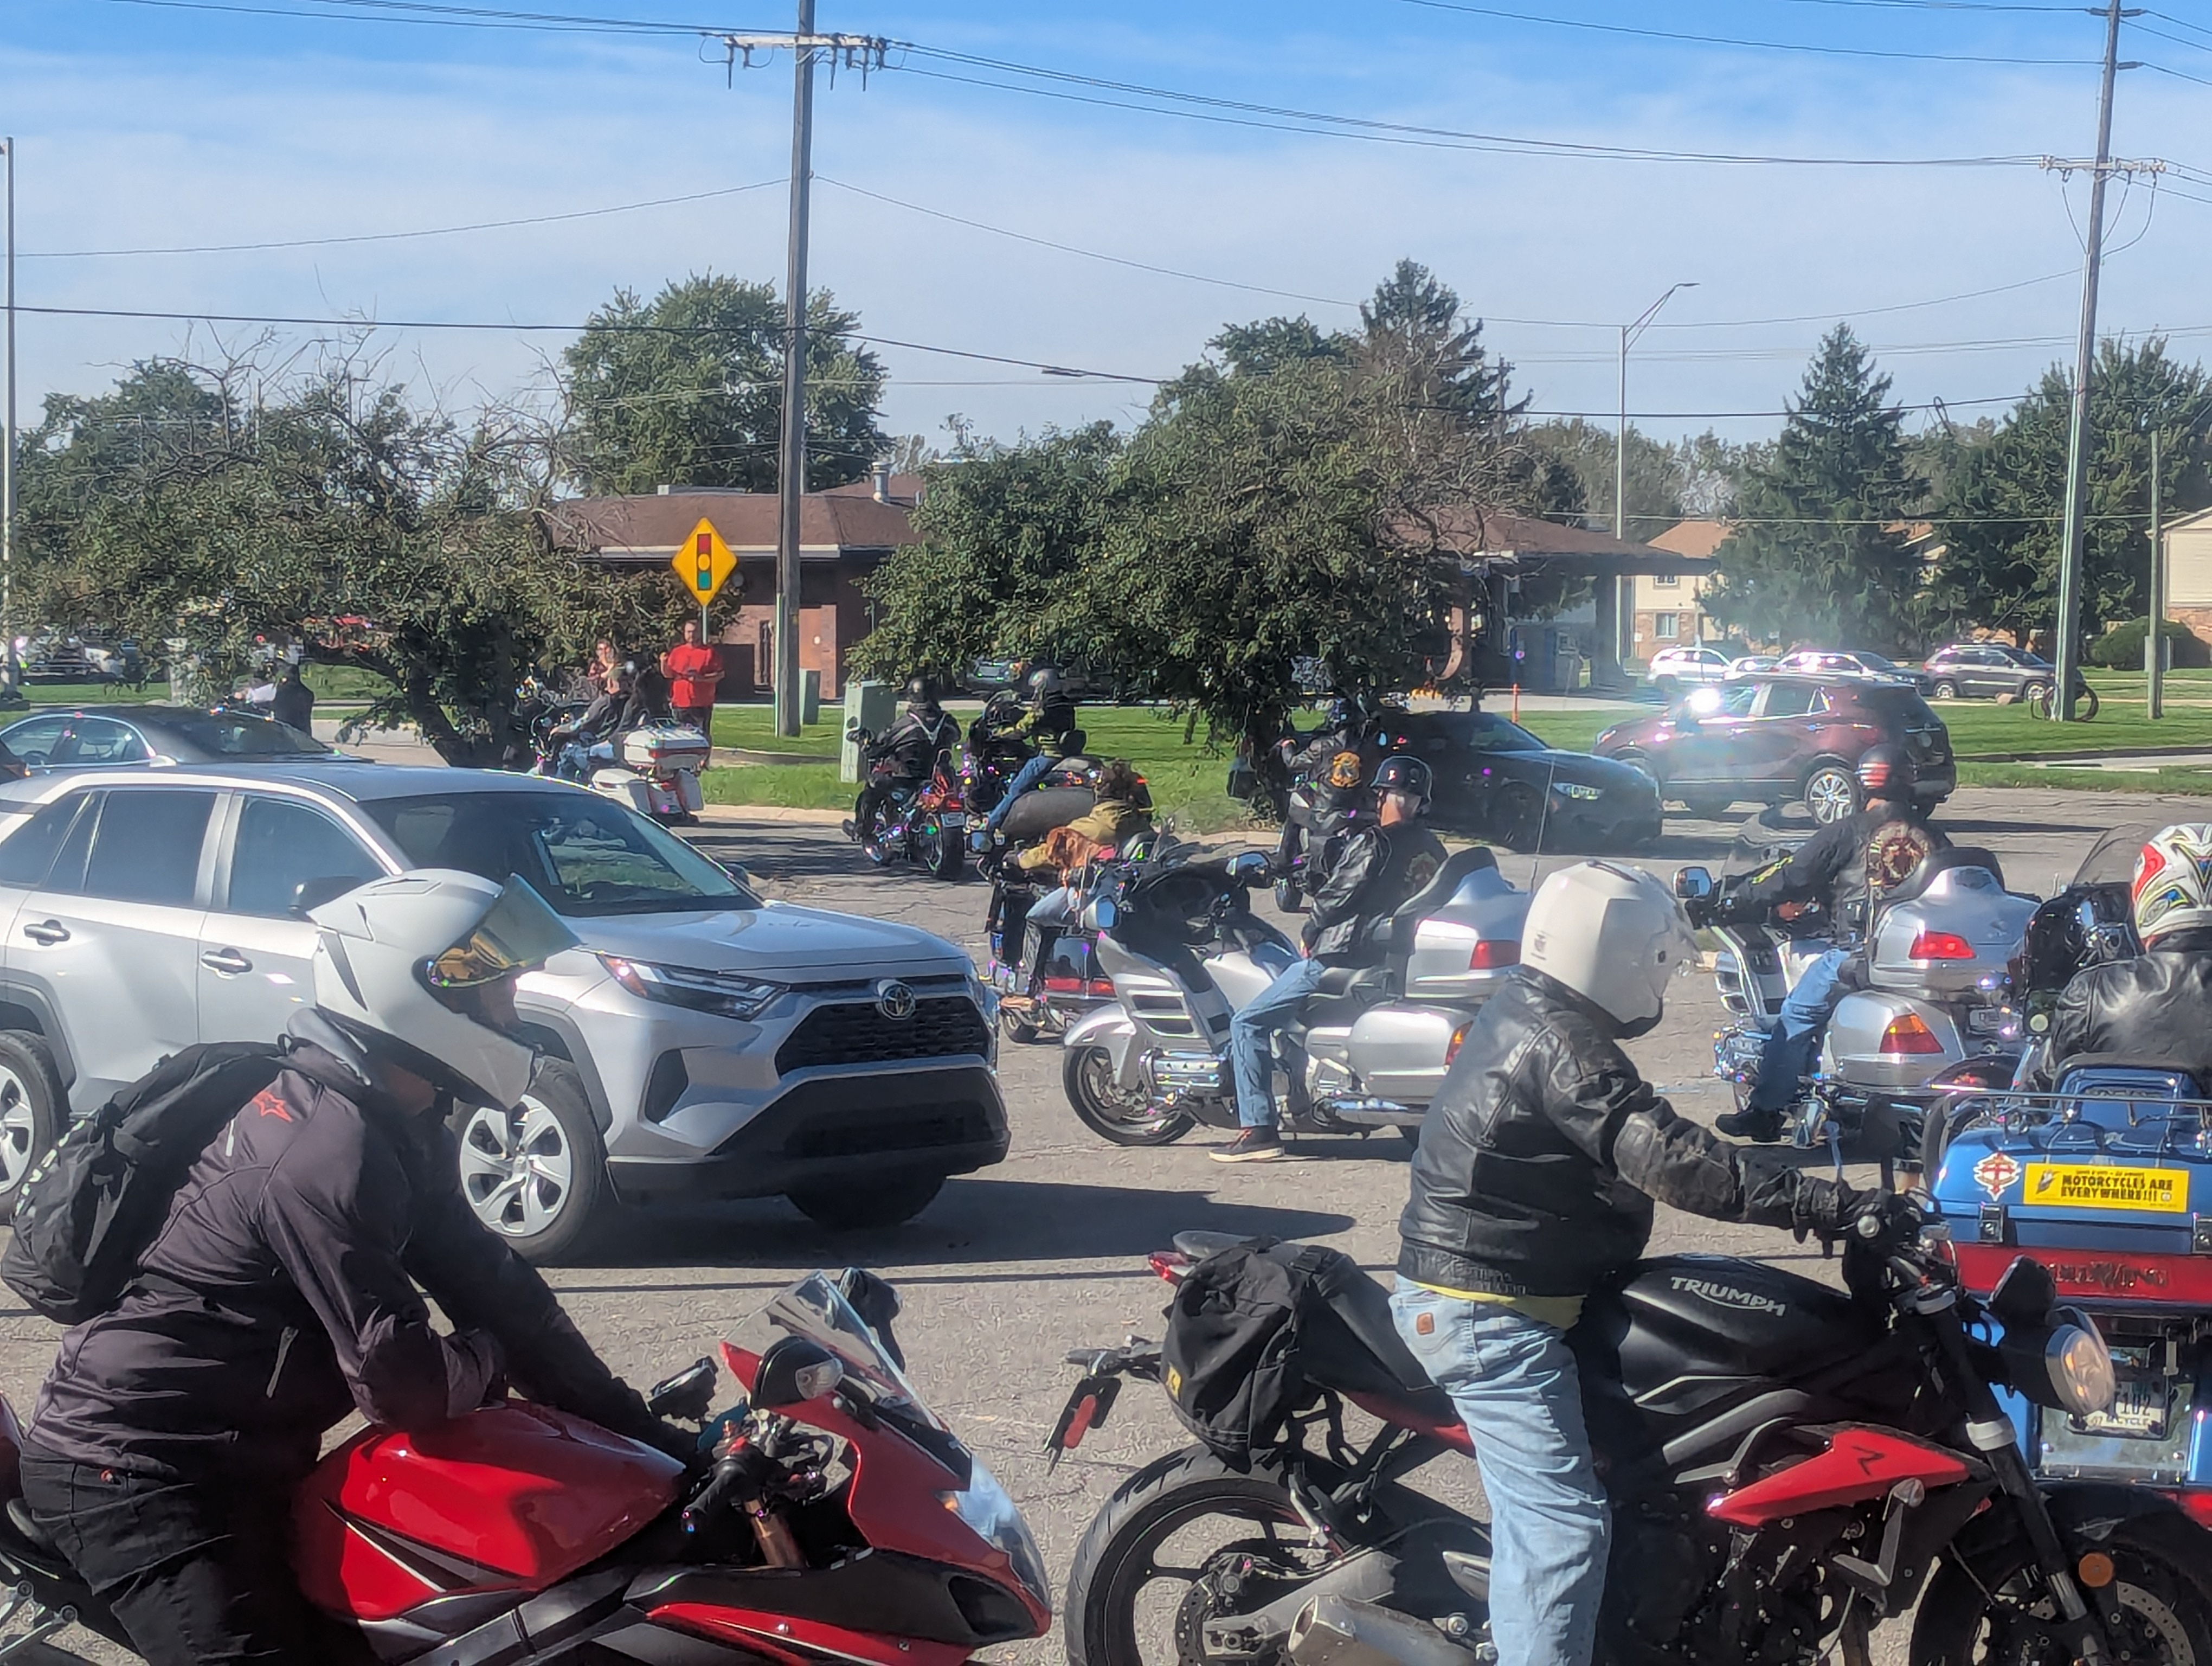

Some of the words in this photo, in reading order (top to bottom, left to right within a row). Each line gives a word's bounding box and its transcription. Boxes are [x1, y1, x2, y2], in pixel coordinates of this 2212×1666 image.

[2062, 1175, 2145, 1189] MOTORCYCLES
[2149, 1179, 2173, 1191] ARE
[1671, 1277, 1785, 1316] TRIUMPH
